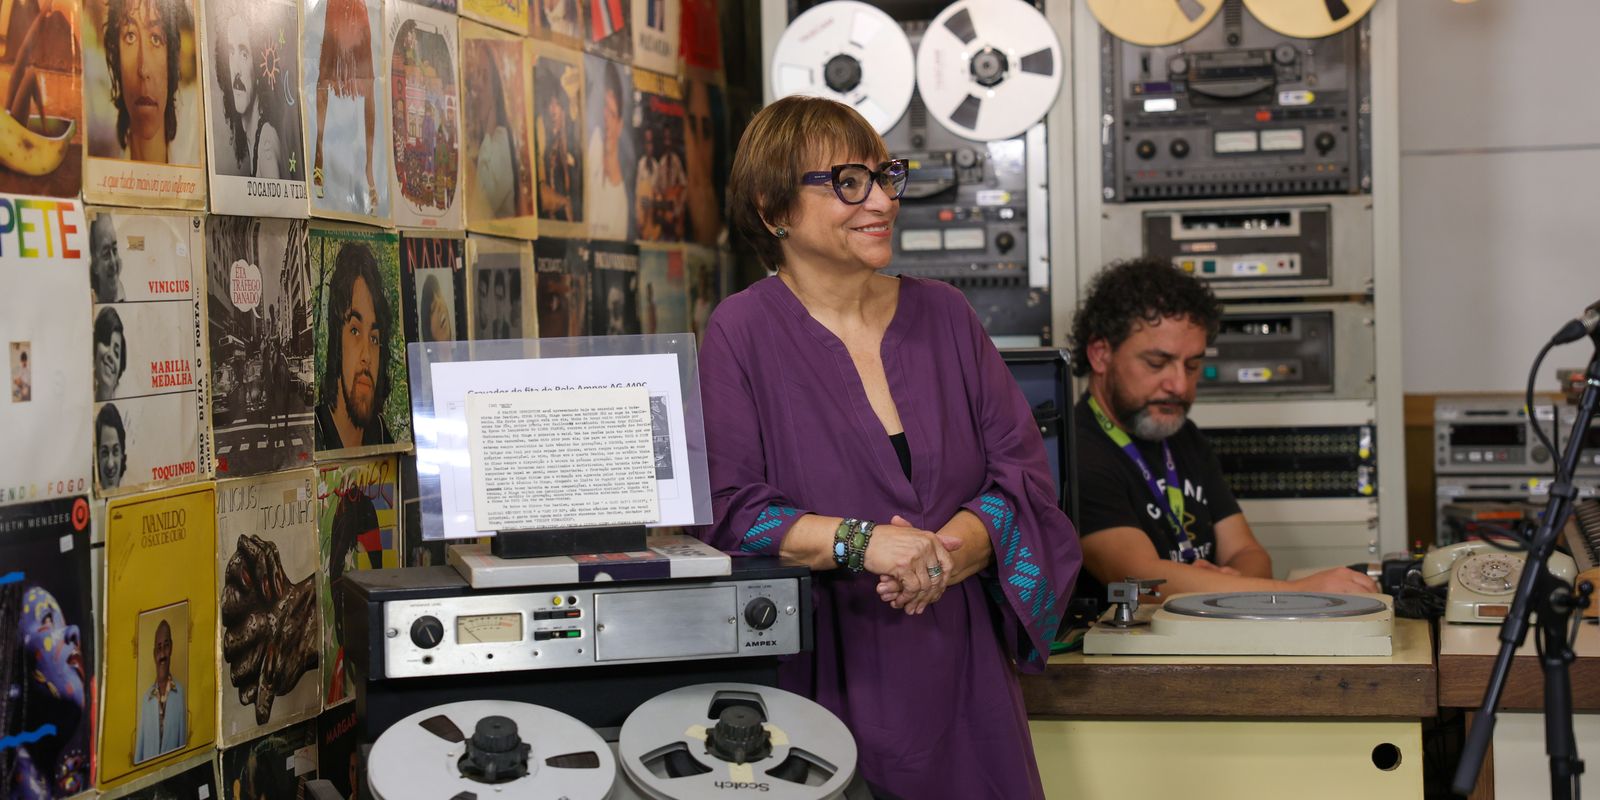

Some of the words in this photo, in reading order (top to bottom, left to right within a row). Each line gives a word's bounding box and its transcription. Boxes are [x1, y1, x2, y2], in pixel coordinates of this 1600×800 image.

[248, 181, 281, 198] TOCANDO
[284, 184, 289, 198] A
[0, 198, 81, 258] PETE
[407, 238, 457, 273] NARA
[149, 281, 190, 294] VINICIUS
[233, 292, 258, 304] DANADO
[151, 360, 190, 374] MARILIA
[197, 358, 202, 368] O
[152, 373, 193, 388] MEDALHA
[152, 461, 196, 480] TOQUINHO
[48, 478, 84, 496] FOGO
[142, 508, 186, 535] IVANILDO
[745, 640, 777, 648] AMPEX
[714, 780, 770, 792] Scotch
